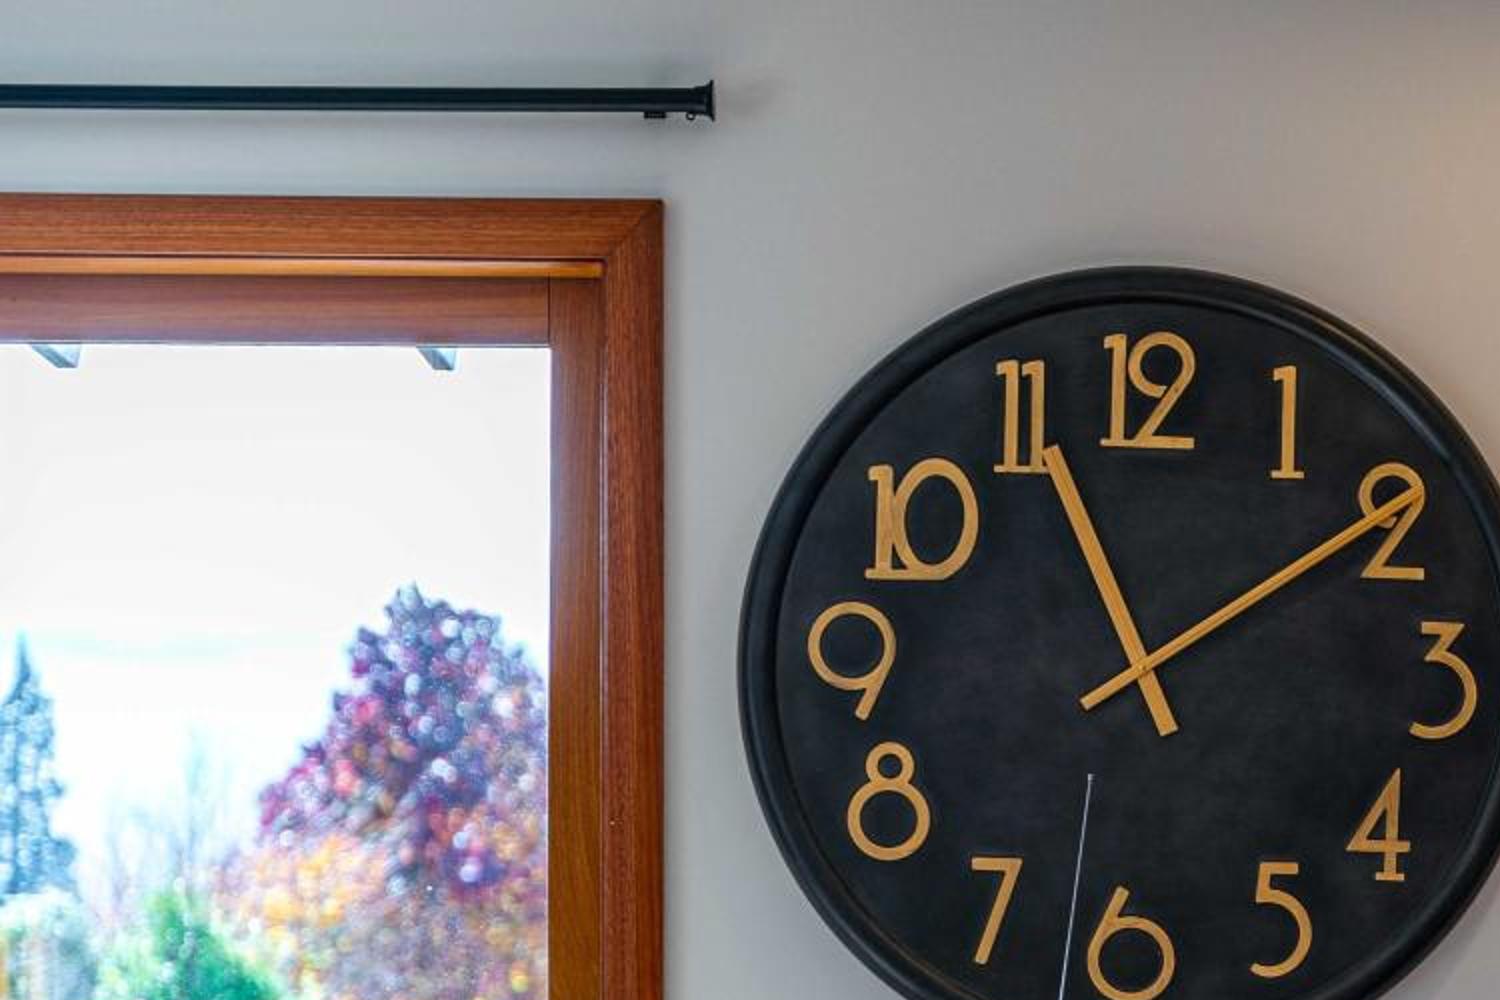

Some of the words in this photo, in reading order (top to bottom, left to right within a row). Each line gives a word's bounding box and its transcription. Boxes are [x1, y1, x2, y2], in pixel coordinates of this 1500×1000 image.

[993, 360, 1050, 473] 11
[1100, 331, 1195, 449] 12
[1271, 366, 1305, 479] 1
[865, 457, 979, 581] 10
[1358, 463, 1426, 580] 2
[807, 602, 896, 720] 9
[1410, 621, 1478, 739] 3
[847, 742, 930, 860] 8
[1346, 768, 1411, 882] 4
[971, 857, 1023, 964] 7
[1250, 862, 1312, 977] 5
